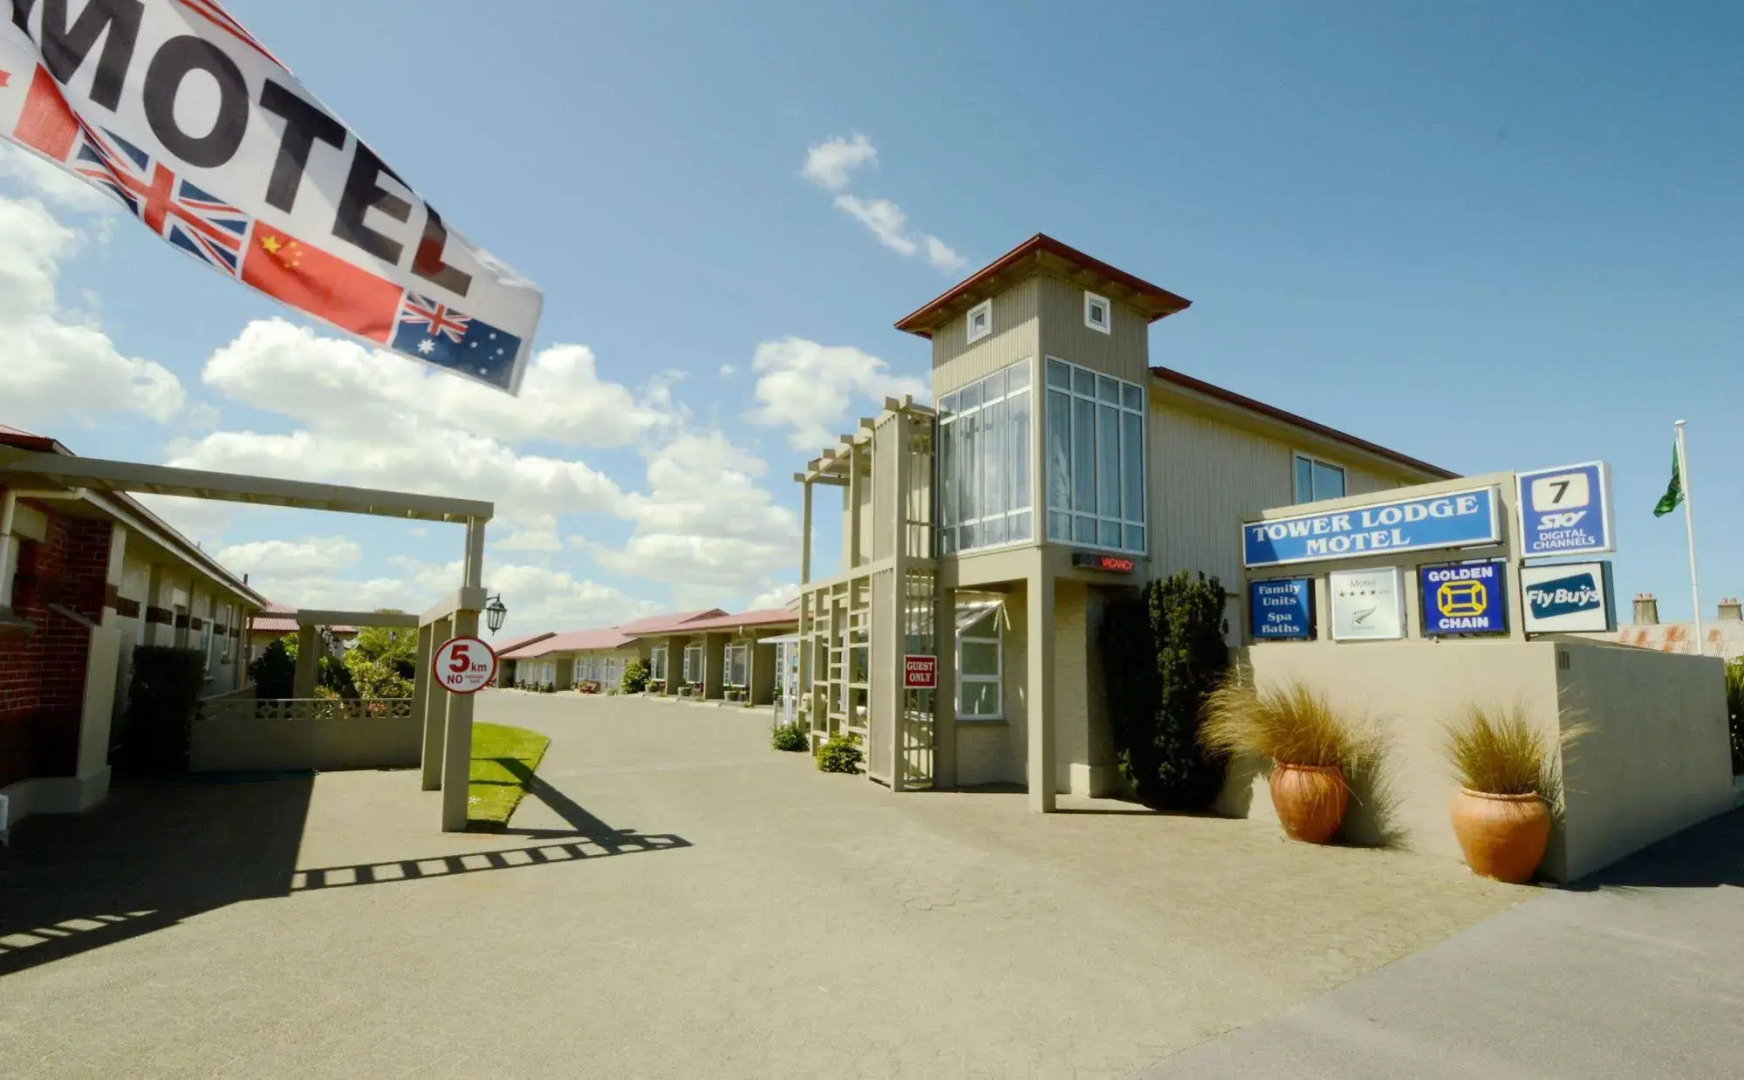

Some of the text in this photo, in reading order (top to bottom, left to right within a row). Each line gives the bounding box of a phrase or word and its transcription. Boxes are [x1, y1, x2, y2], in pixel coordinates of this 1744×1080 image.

[12, 0, 472, 298] MOTEL
[1549, 480, 1570, 504] 7
[1253, 495, 1478, 541] TOWER LODGE
[1537, 510, 1588, 530] SKY
[1539, 528, 1587, 541] DIGITAL
[1306, 528, 1411, 556] MOTEL
[1533, 536, 1595, 550] CHANNELS
[1101, 557, 1134, 571] VACANCY
[1428, 566, 1493, 582] GOLDEN
[1258, 584, 1301, 596] Family
[1350, 578, 1376, 588] Motel
[1262, 597, 1297, 606] Units
[1267, 612, 1293, 623] Spa
[1438, 616, 1489, 630] CHAIN
[1261, 623, 1300, 633] Baths
[449, 644, 487, 673] 5 km
[906, 661, 933, 671] GUEST
[447, 674, 463, 684] NO
[909, 672, 931, 682] ONLY
